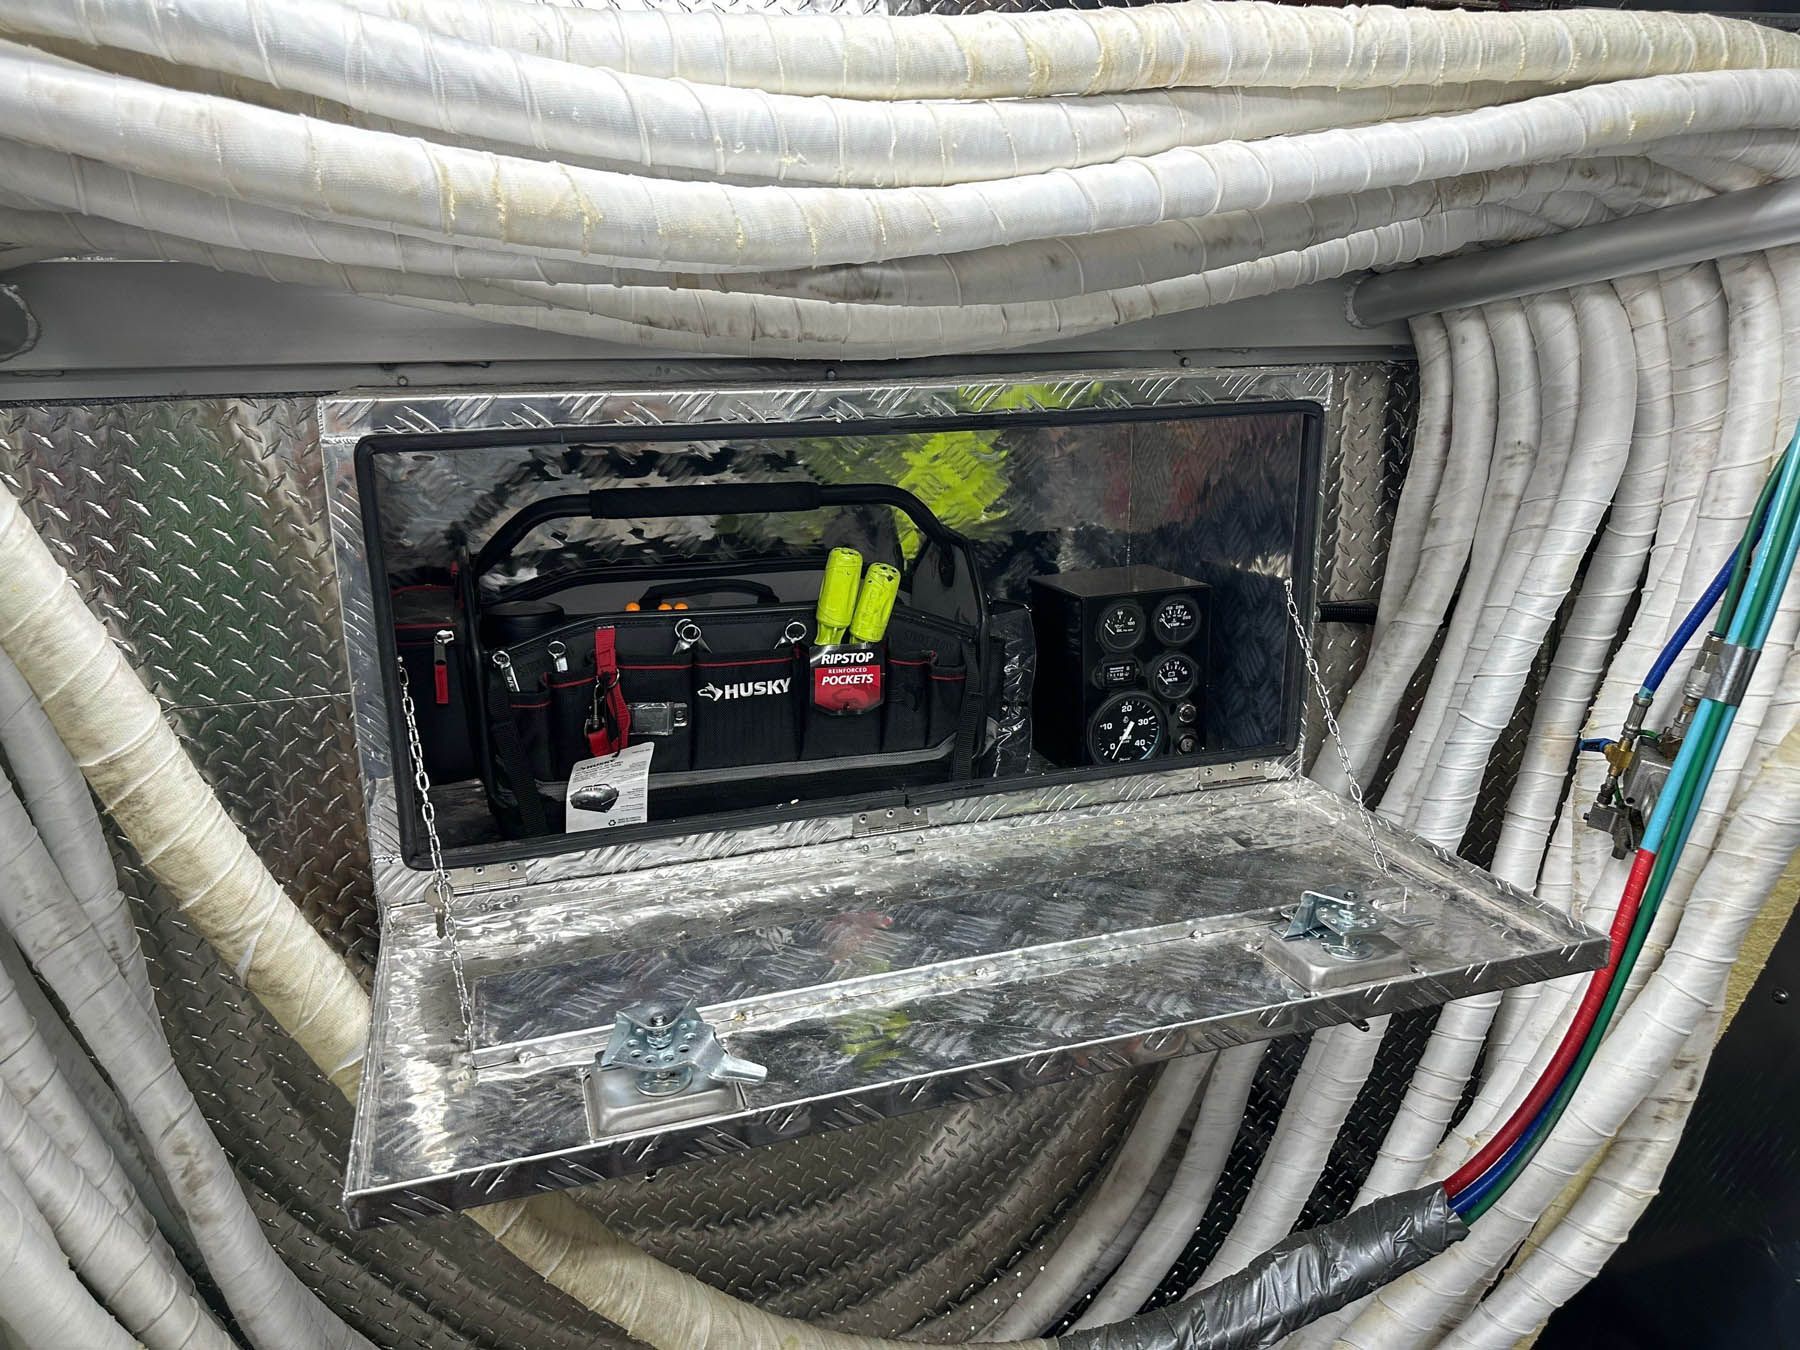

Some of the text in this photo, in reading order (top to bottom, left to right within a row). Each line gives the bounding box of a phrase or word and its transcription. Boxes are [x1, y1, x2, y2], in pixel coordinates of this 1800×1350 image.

[821, 652, 874, 665] RIPSTOP
[822, 674, 874, 686] POCKETS
[724, 677, 792, 700] HUSKY
[1121, 704, 1133, 713] 20
[1103, 722, 1113, 730] 10
[1137, 718, 1149, 726] 30
[1134, 739, 1146, 747] 40
